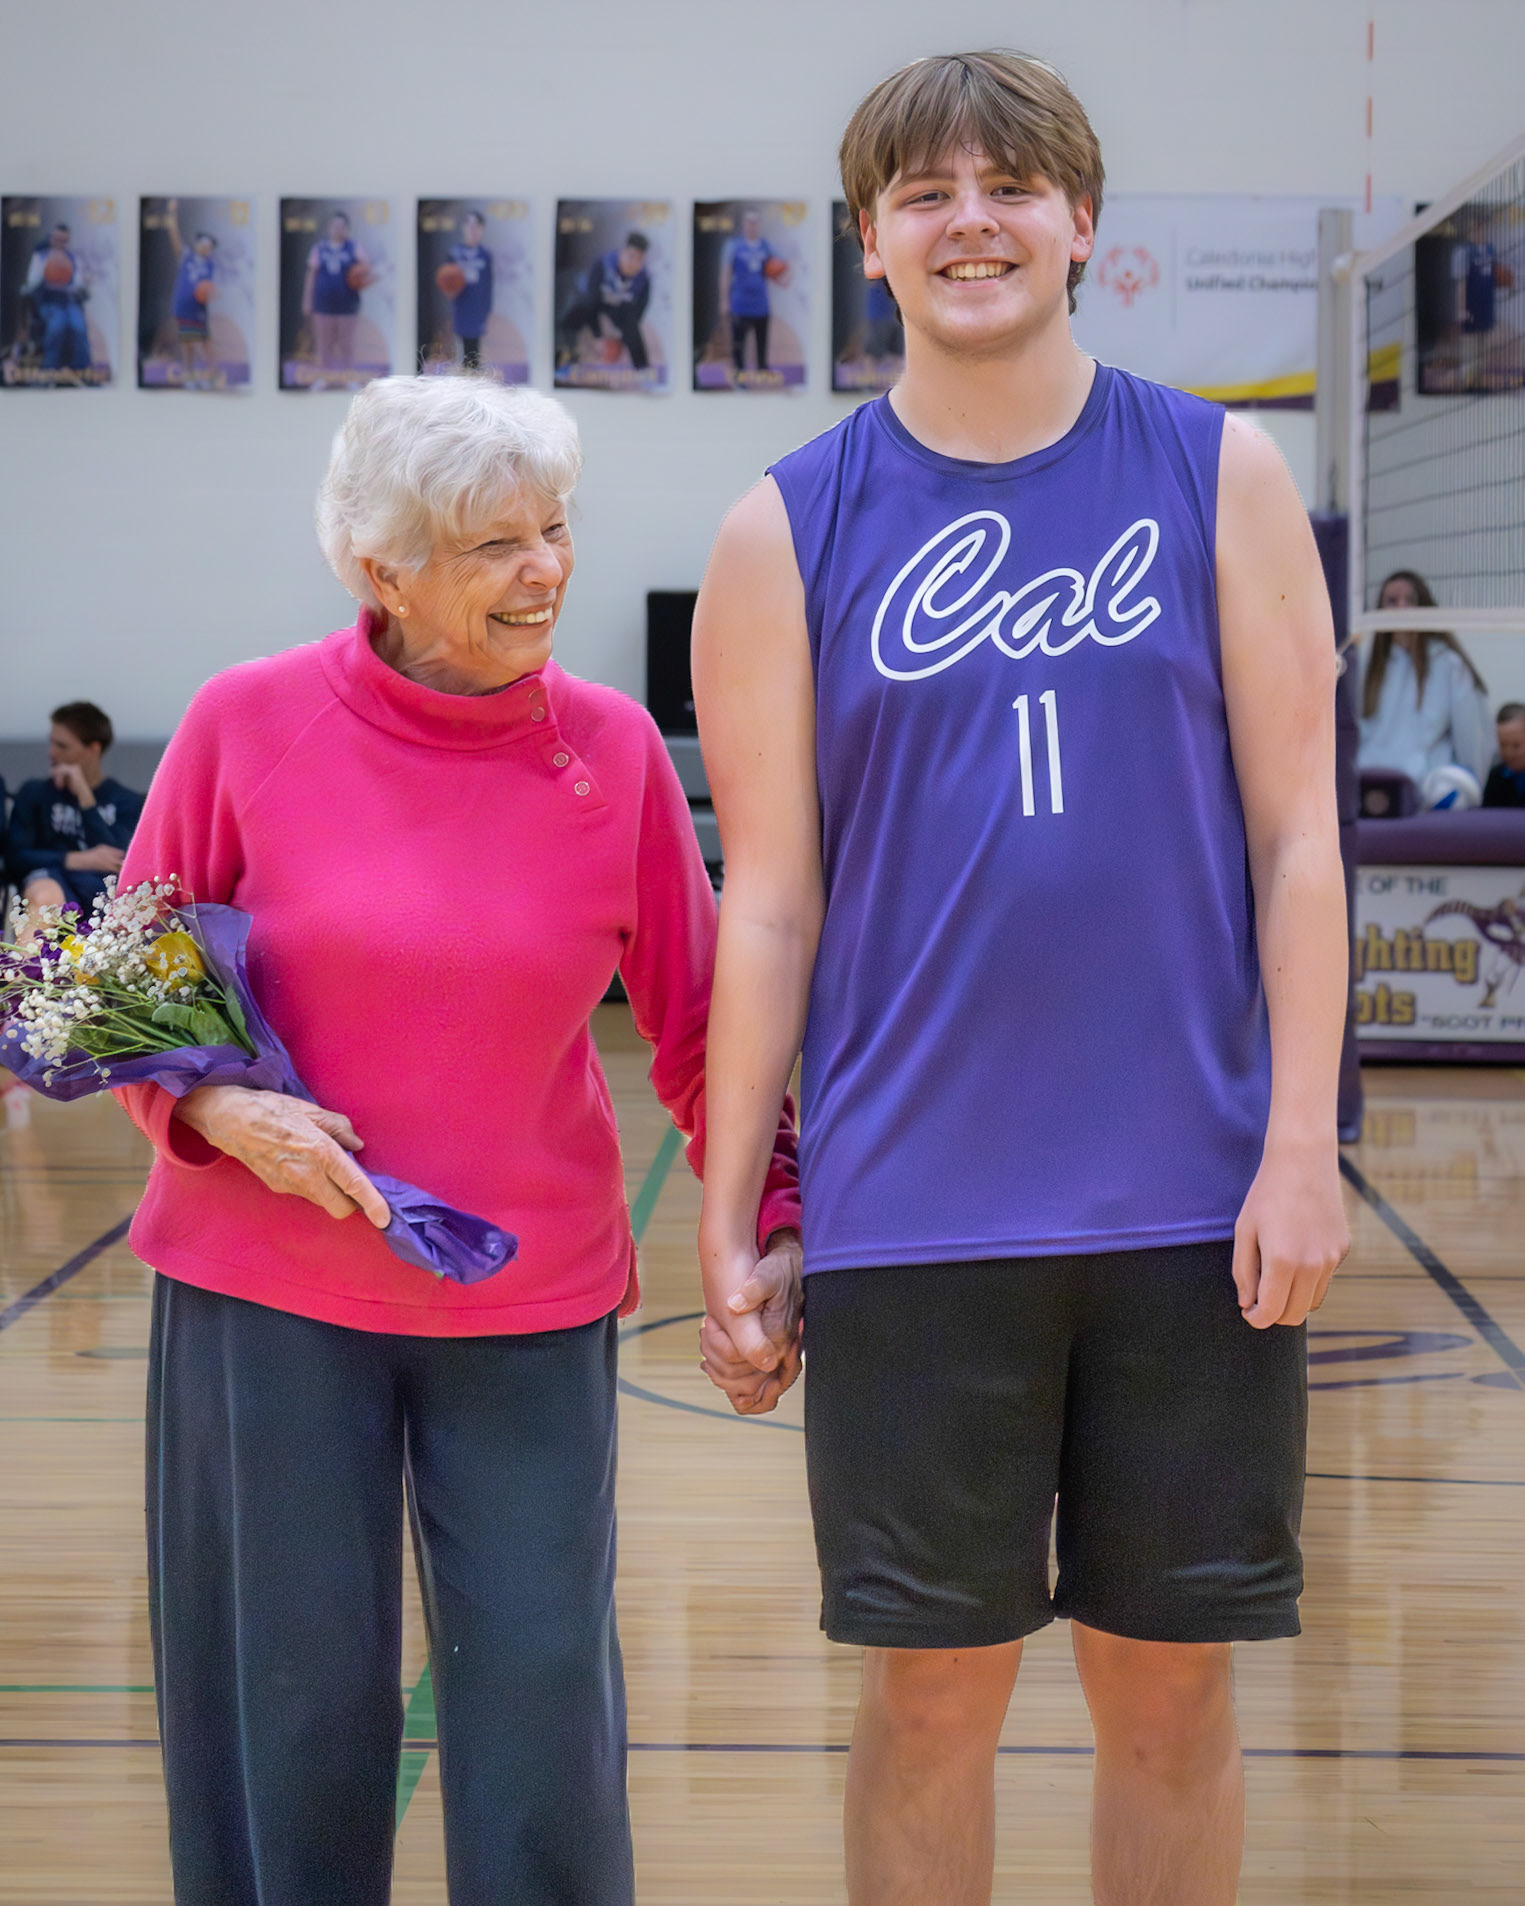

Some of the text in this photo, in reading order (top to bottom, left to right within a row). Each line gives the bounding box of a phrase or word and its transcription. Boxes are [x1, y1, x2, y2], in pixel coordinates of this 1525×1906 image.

[1186, 275, 1244, 291] Unified
[871, 509, 1162, 681] Cal
[1012, 689, 1064, 817] 11
[1368, 876, 1395, 895] OF
[1406, 877, 1448, 896] THE
